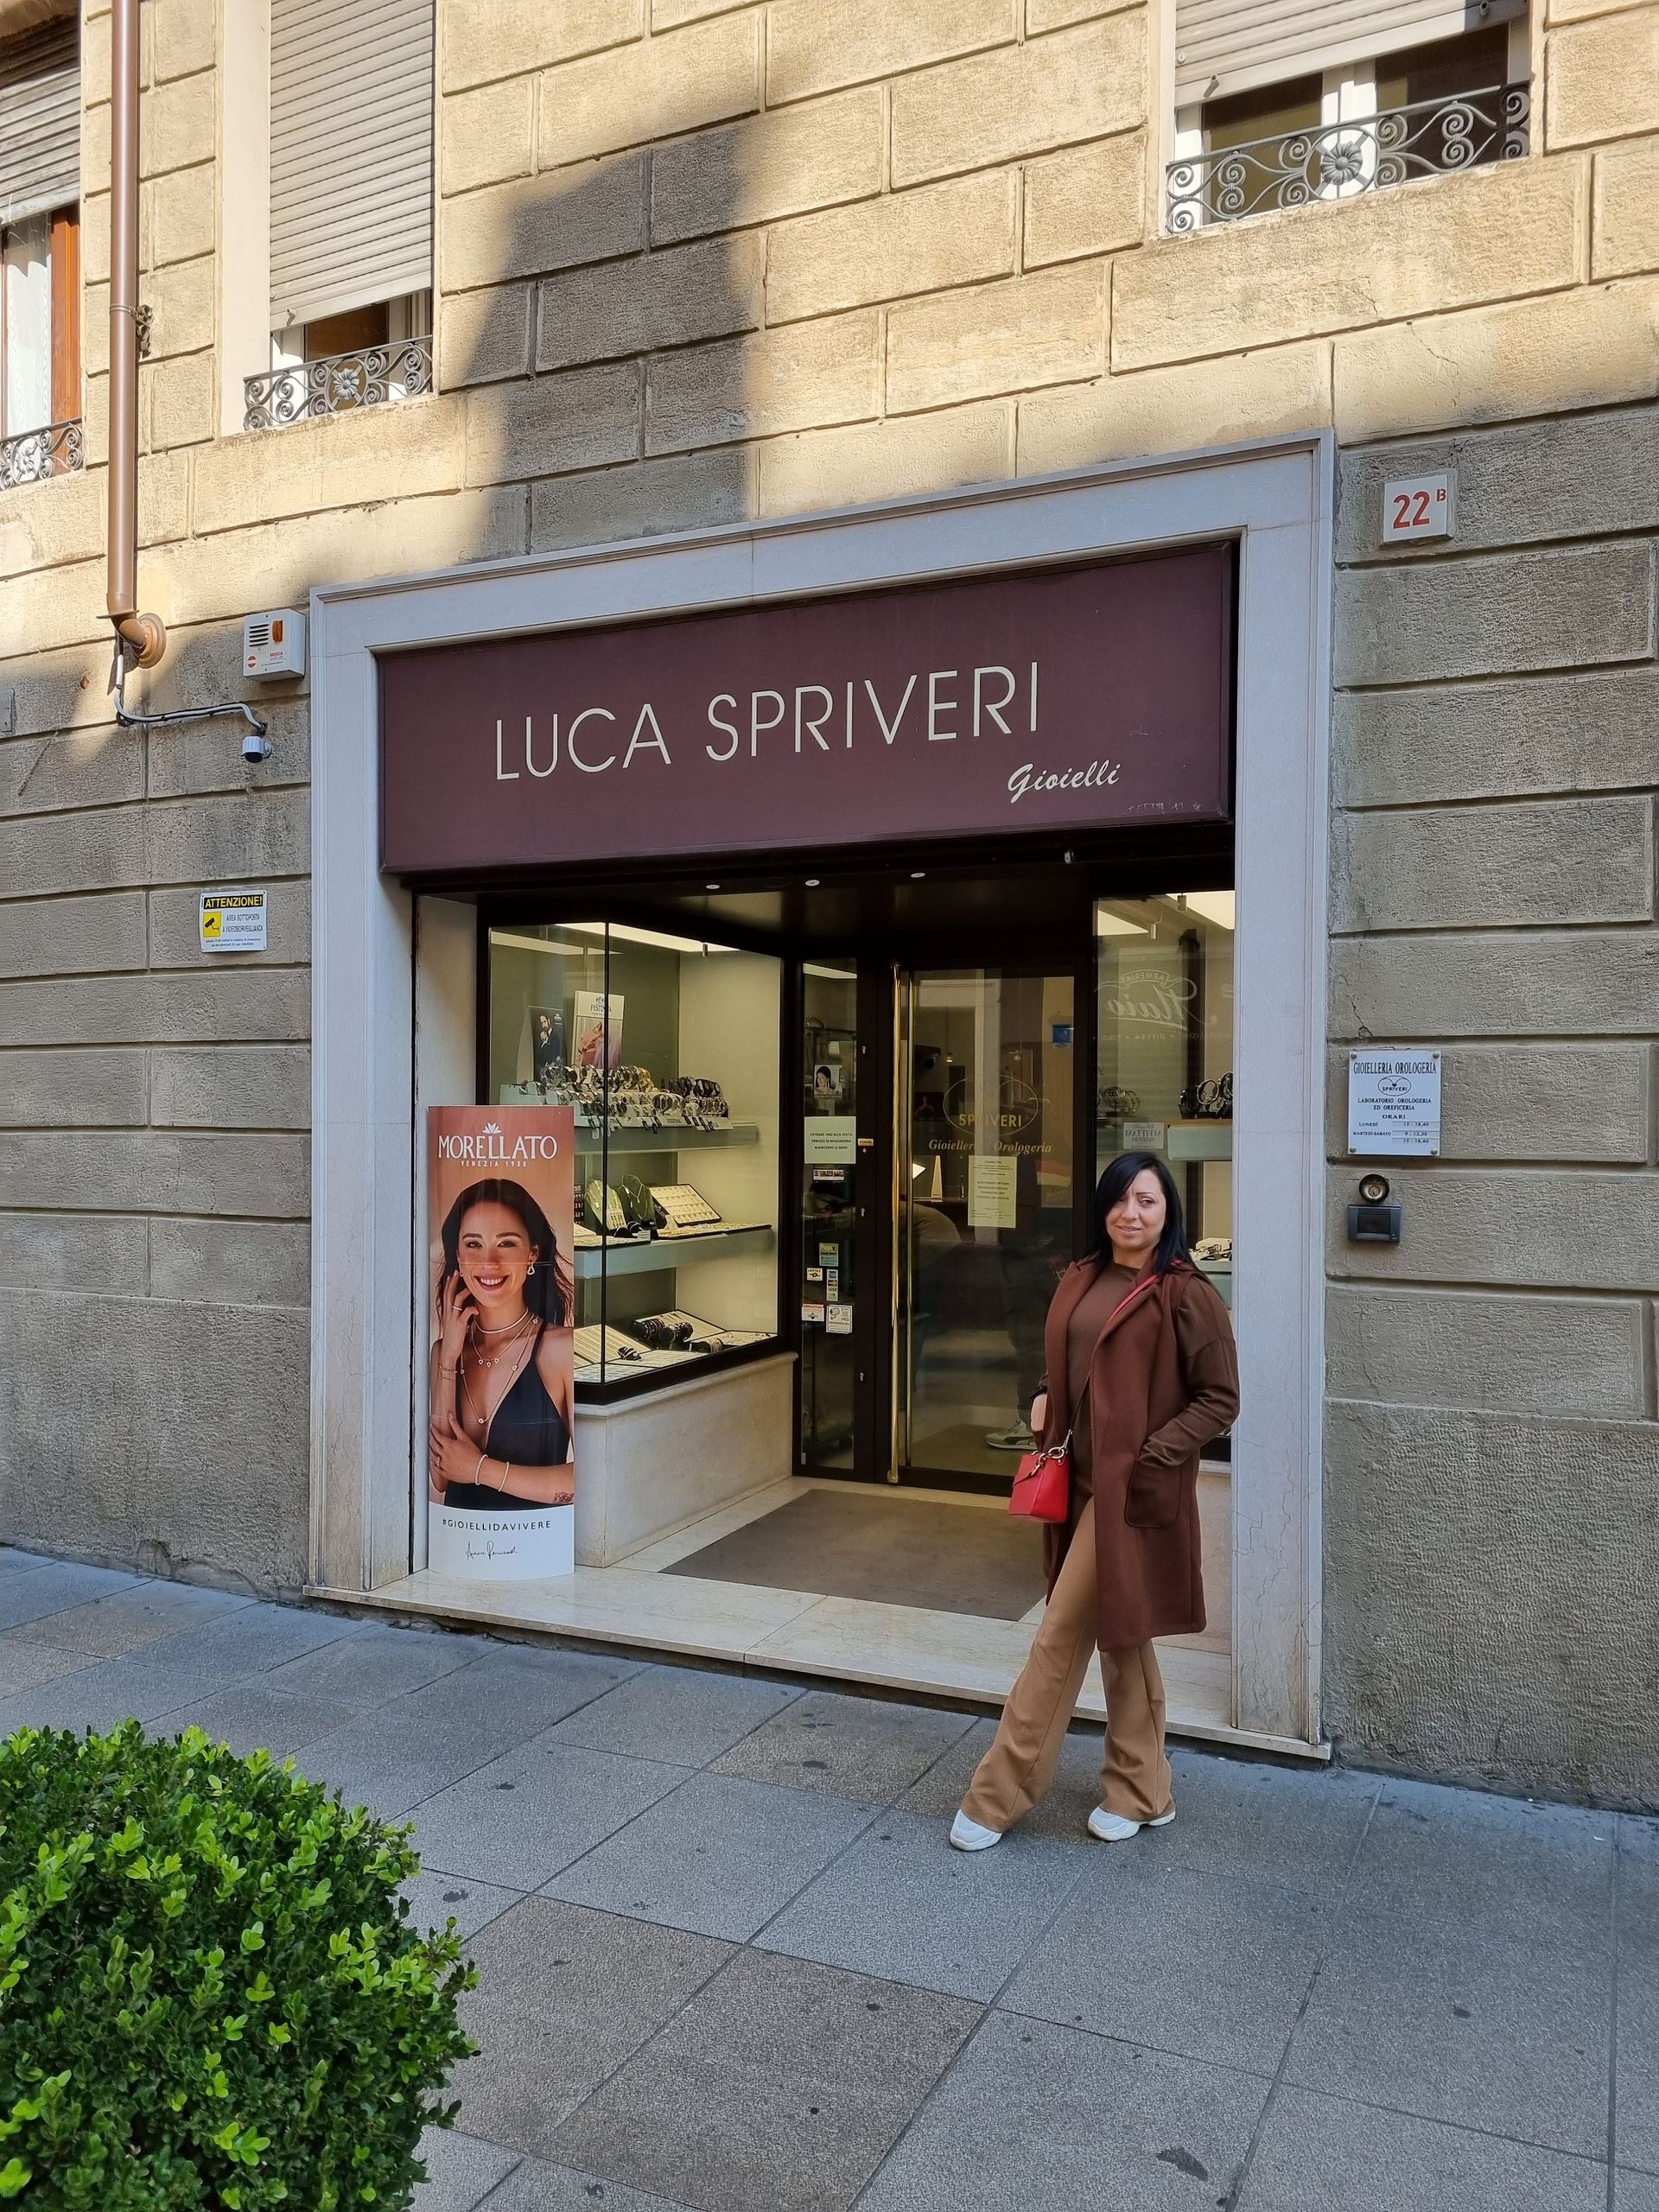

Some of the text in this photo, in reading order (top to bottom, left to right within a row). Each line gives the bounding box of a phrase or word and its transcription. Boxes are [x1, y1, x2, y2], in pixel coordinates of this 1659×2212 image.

[1393, 488, 1446, 529] 22 B
[497, 661, 1038, 779] LUCA SPRIVERI
[1007, 760, 1121, 804] Gioielli
[205, 896, 263, 909] ATTENZIONE!
[590, 1004, 612, 1014] FESTIA
[1353, 1062, 1437, 1074] GIOIELLERIA OROLOGERIA
[438, 1135, 557, 1159] MORELLATO
[995, 1141, 1052, 1155] Orologeria
[442, 1518, 551, 1531] #GIOIELLIDAVIVERE
